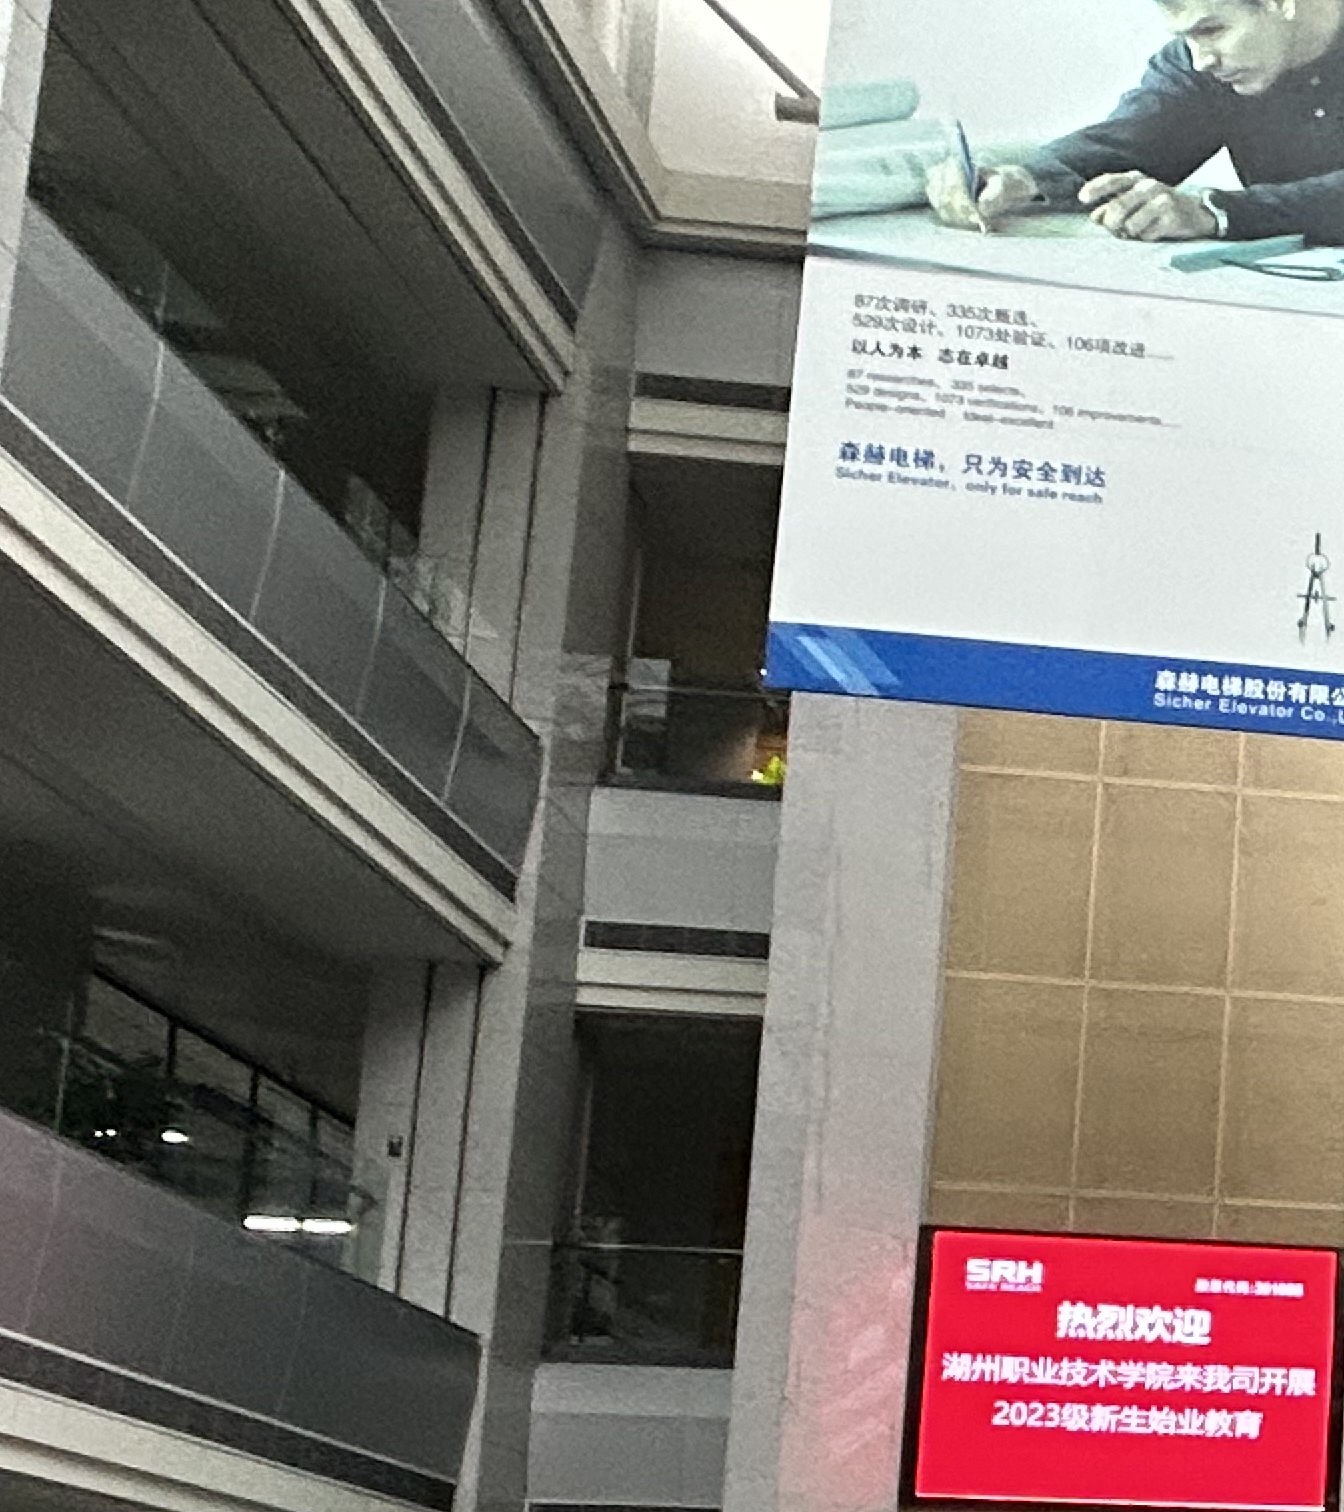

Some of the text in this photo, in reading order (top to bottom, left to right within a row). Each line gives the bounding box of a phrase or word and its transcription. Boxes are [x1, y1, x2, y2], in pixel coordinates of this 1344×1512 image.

[852, 338, 1010, 370] 以人为本 志在卓越
[835, 466, 882, 481] Sicher
[965, 481, 998, 496] only
[1002, 483, 1023, 496] for
[1153, 692, 1212, 711] Sicher
[1218, 698, 1295, 719] Elevator
[965, 1257, 1044, 1284] SRH
[1055, 1300, 1213, 1346] 热烈欢迎
[941, 1351, 1318, 1397] 湖州职业技术学院来我司开展
[991, 1399, 1264, 1440] 2023级新生始业教育
